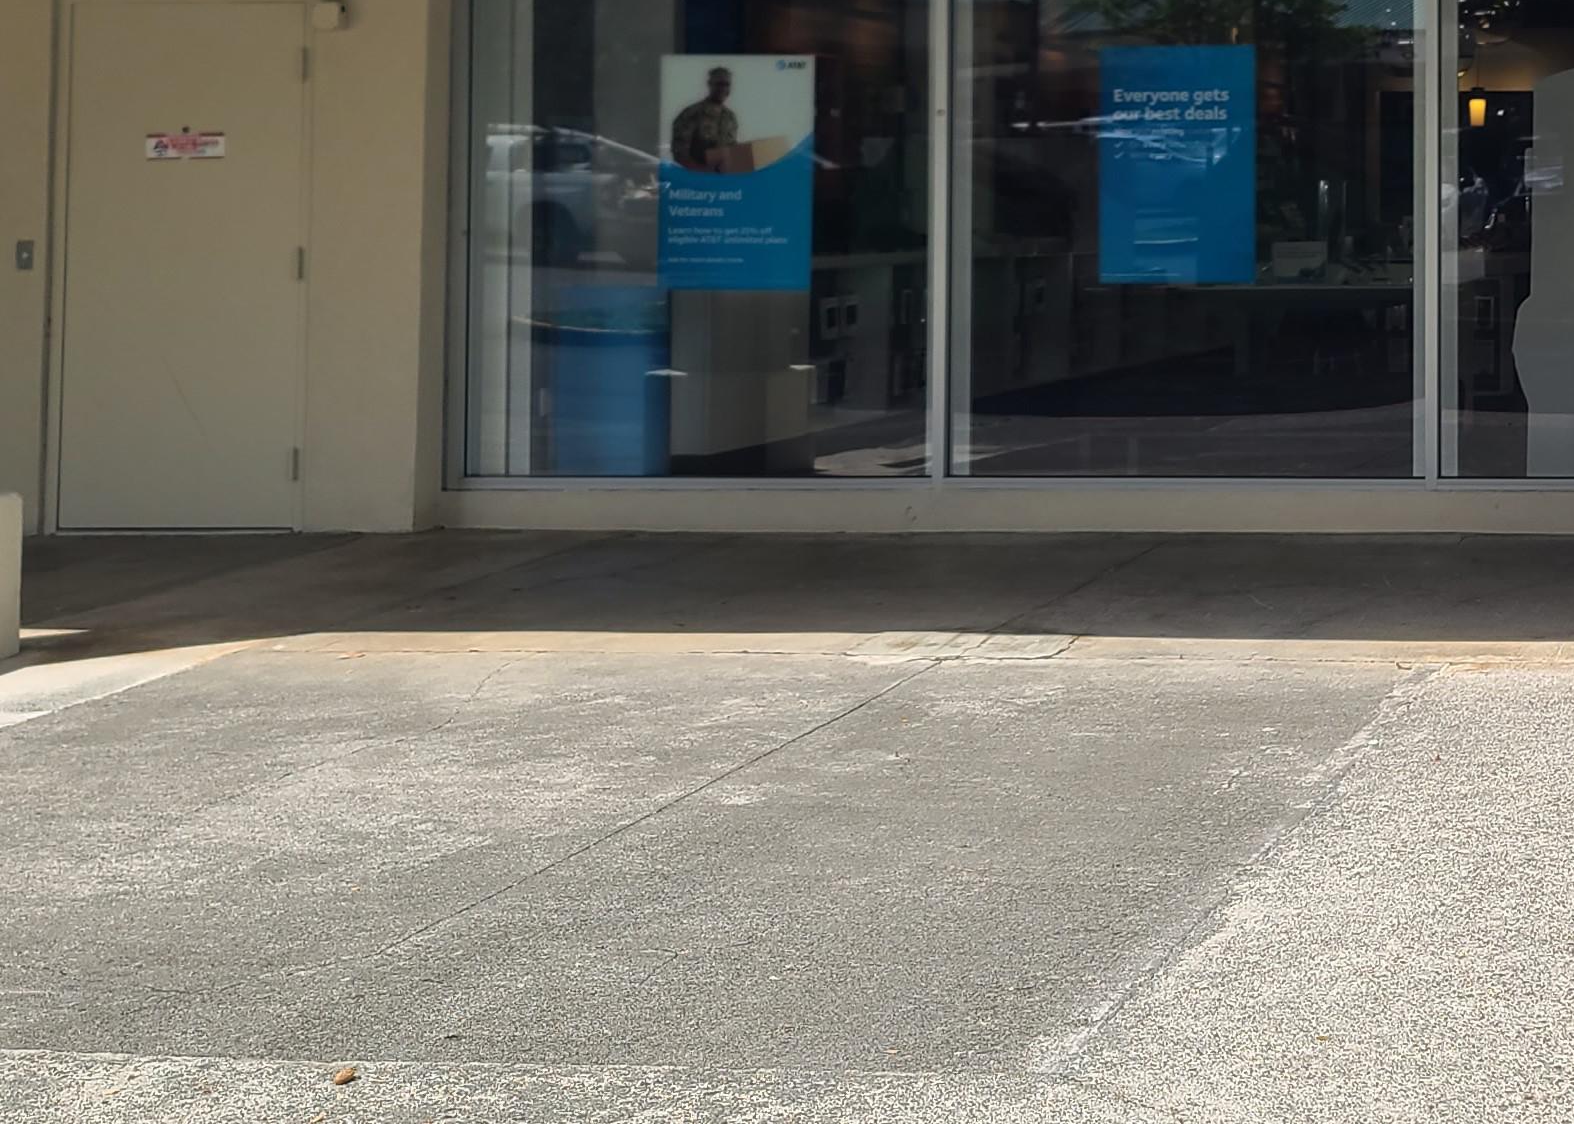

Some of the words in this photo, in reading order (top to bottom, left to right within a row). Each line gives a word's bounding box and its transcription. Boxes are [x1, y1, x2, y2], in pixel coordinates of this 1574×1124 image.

[1113, 89, 1190, 105] Everyone
[1193, 89, 1229, 105] gets
[1112, 109, 1141, 120] our
[1144, 107, 1182, 120] best
[1184, 106, 1228, 120] deals
[669, 188, 717, 203] Military
[719, 188, 743, 201] and
[669, 205, 724, 217] Veterans
